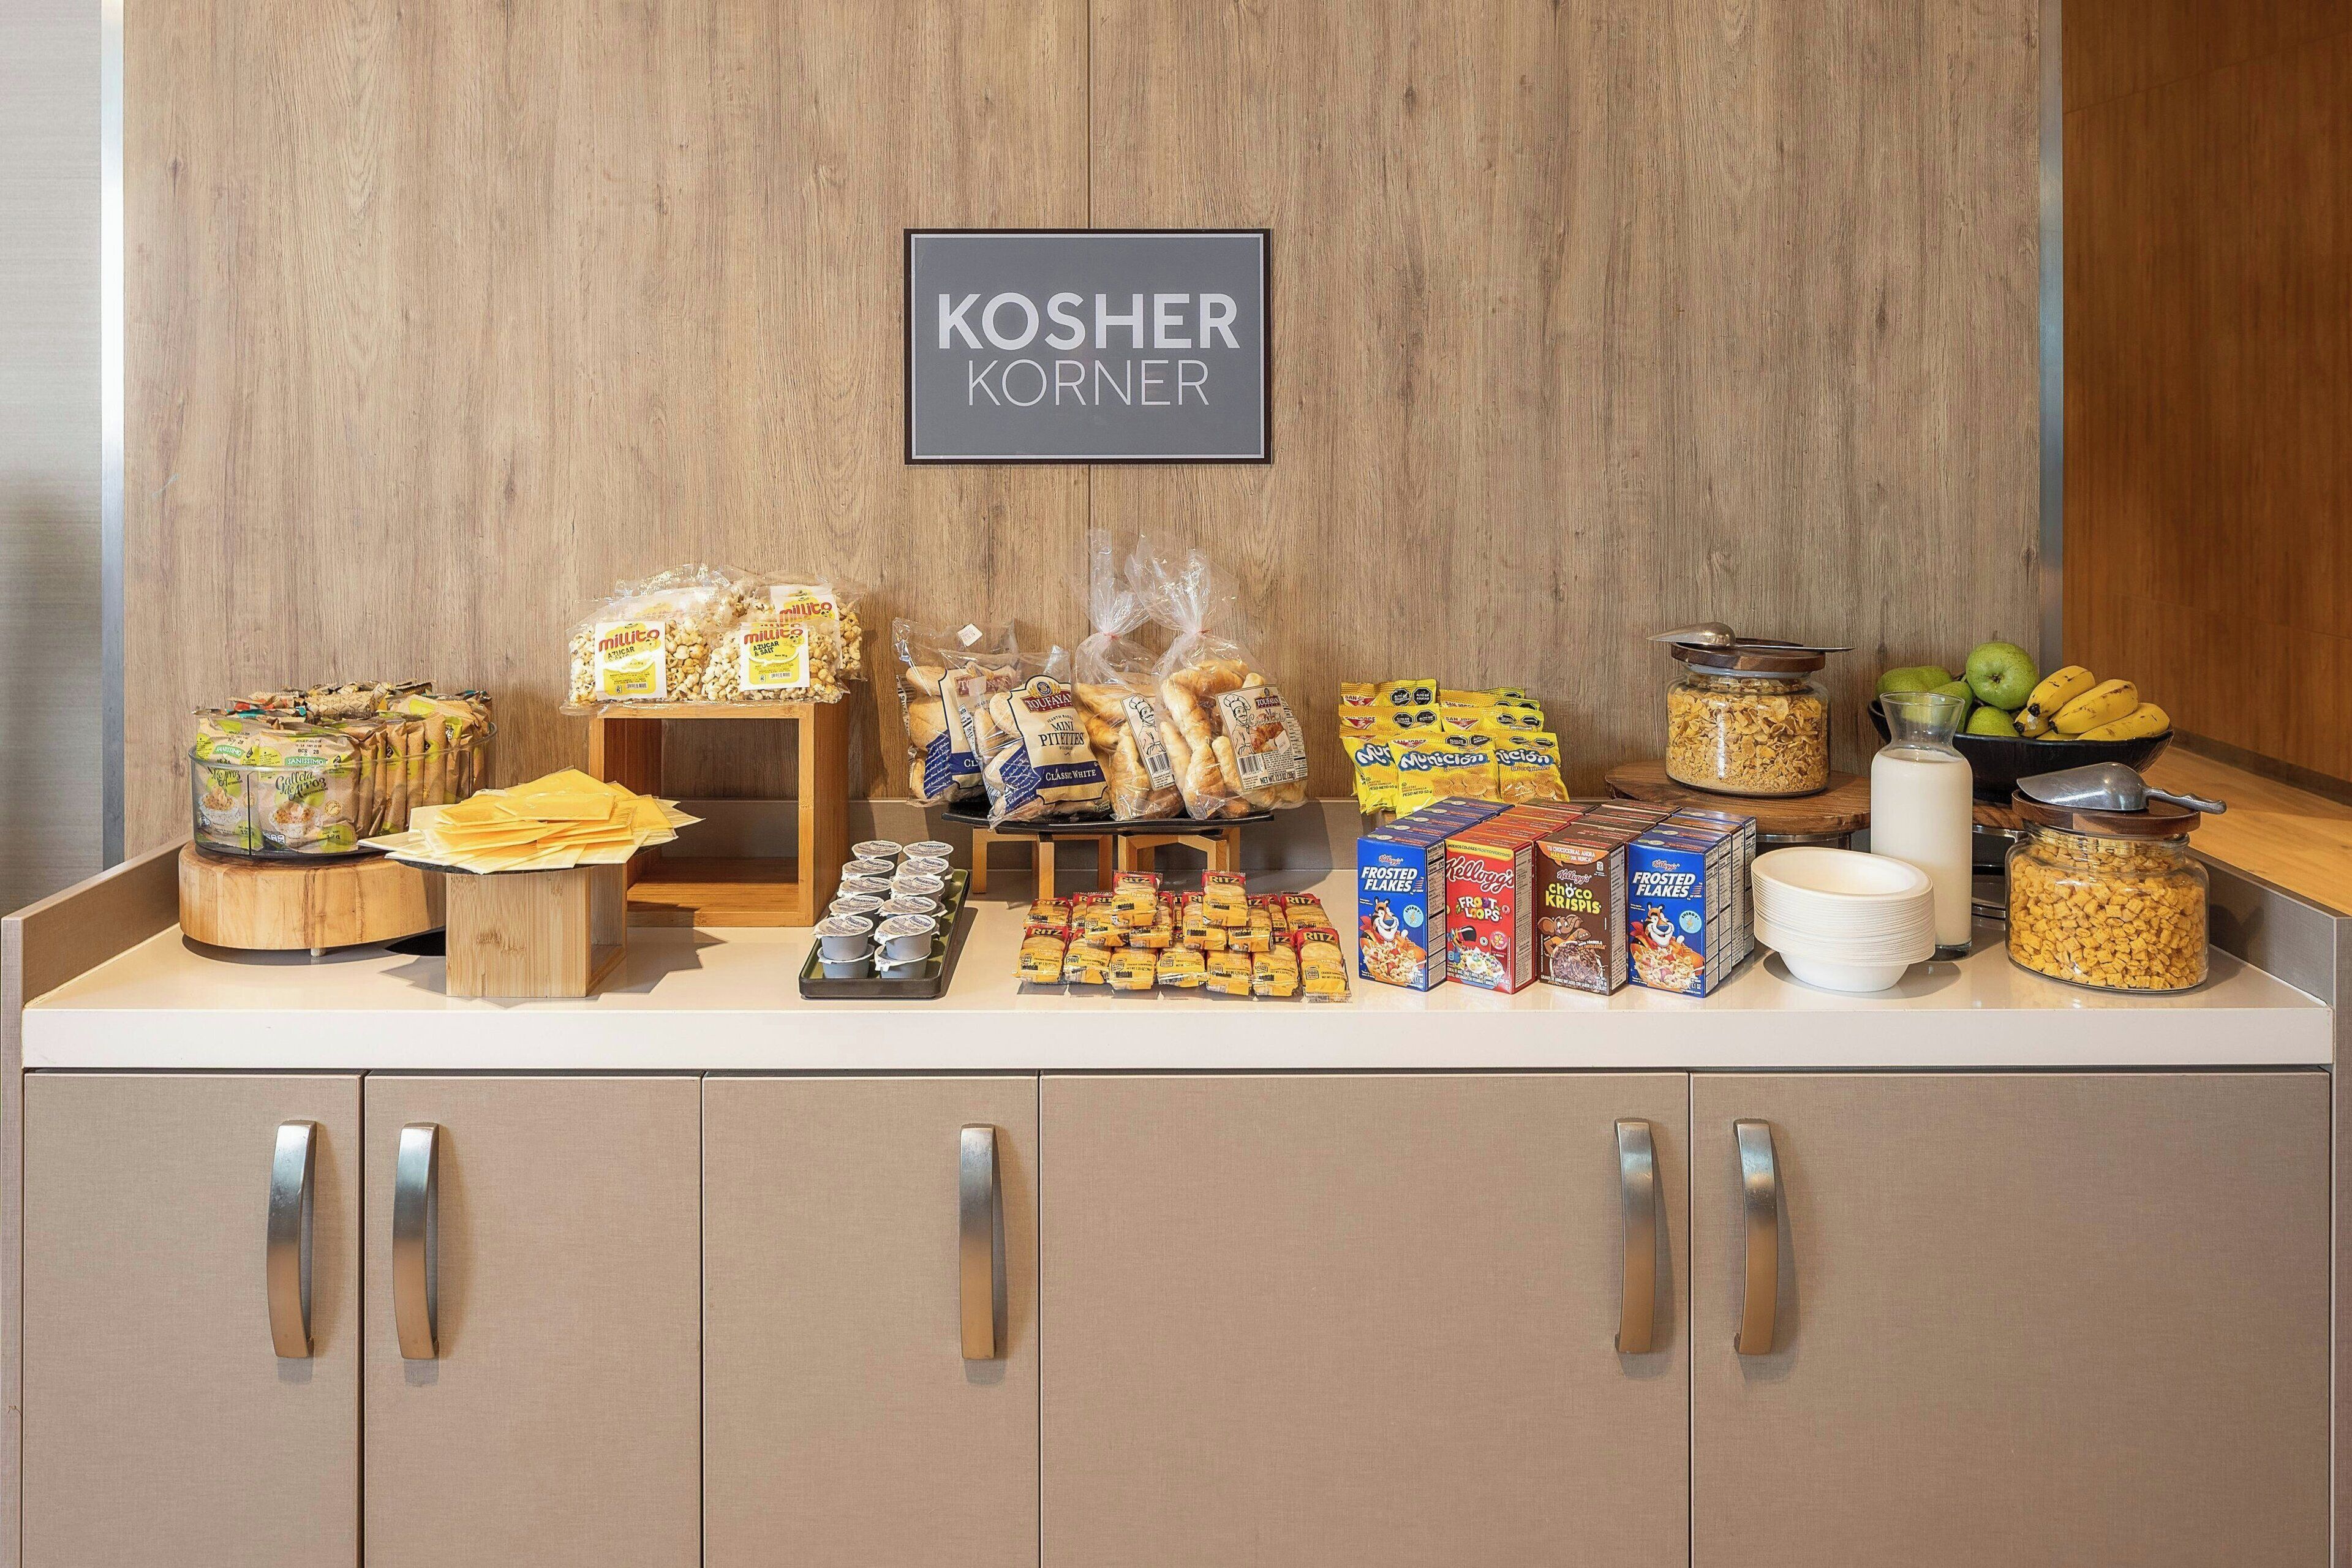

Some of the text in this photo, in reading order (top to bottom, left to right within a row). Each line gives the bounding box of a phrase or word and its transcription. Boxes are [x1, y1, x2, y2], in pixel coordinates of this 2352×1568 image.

[938, 292, 1240, 350] KOSHER
[968, 359, 1209, 407] KORNER
[598, 629, 660, 652] millito
[744, 628, 803, 645] millito
[608, 646, 635, 659] AZUCAR
[753, 641, 779, 651] AZUCAR
[761, 647, 774, 655] SALT
[1050, 721, 1074, 731] MINI
[1046, 769, 1096, 781] CLASSIC WHITE
[276, 771, 314, 794] Galleta
[288, 777, 327, 801] Arroz
[1553, 846, 1580, 856] CHOCOCEREAL
[1379, 854, 1401, 865] Kellogg's
[1653, 859, 1677, 871] Kellogg's
[1361, 867, 1418, 880] FROSTED
[1446, 856, 1515, 894] Kellogg's
[1557, 869, 1590, 885] Kellogg's
[1632, 872, 1696, 885] FROSTED
[1364, 879, 1412, 892] FLAKES
[1636, 884, 1690, 897] FLAKES
[1545, 890, 1601, 914] KRISPIS
[1464, 907, 1501, 922] LOOPS
[1303, 932, 1335, 941] RITZ
